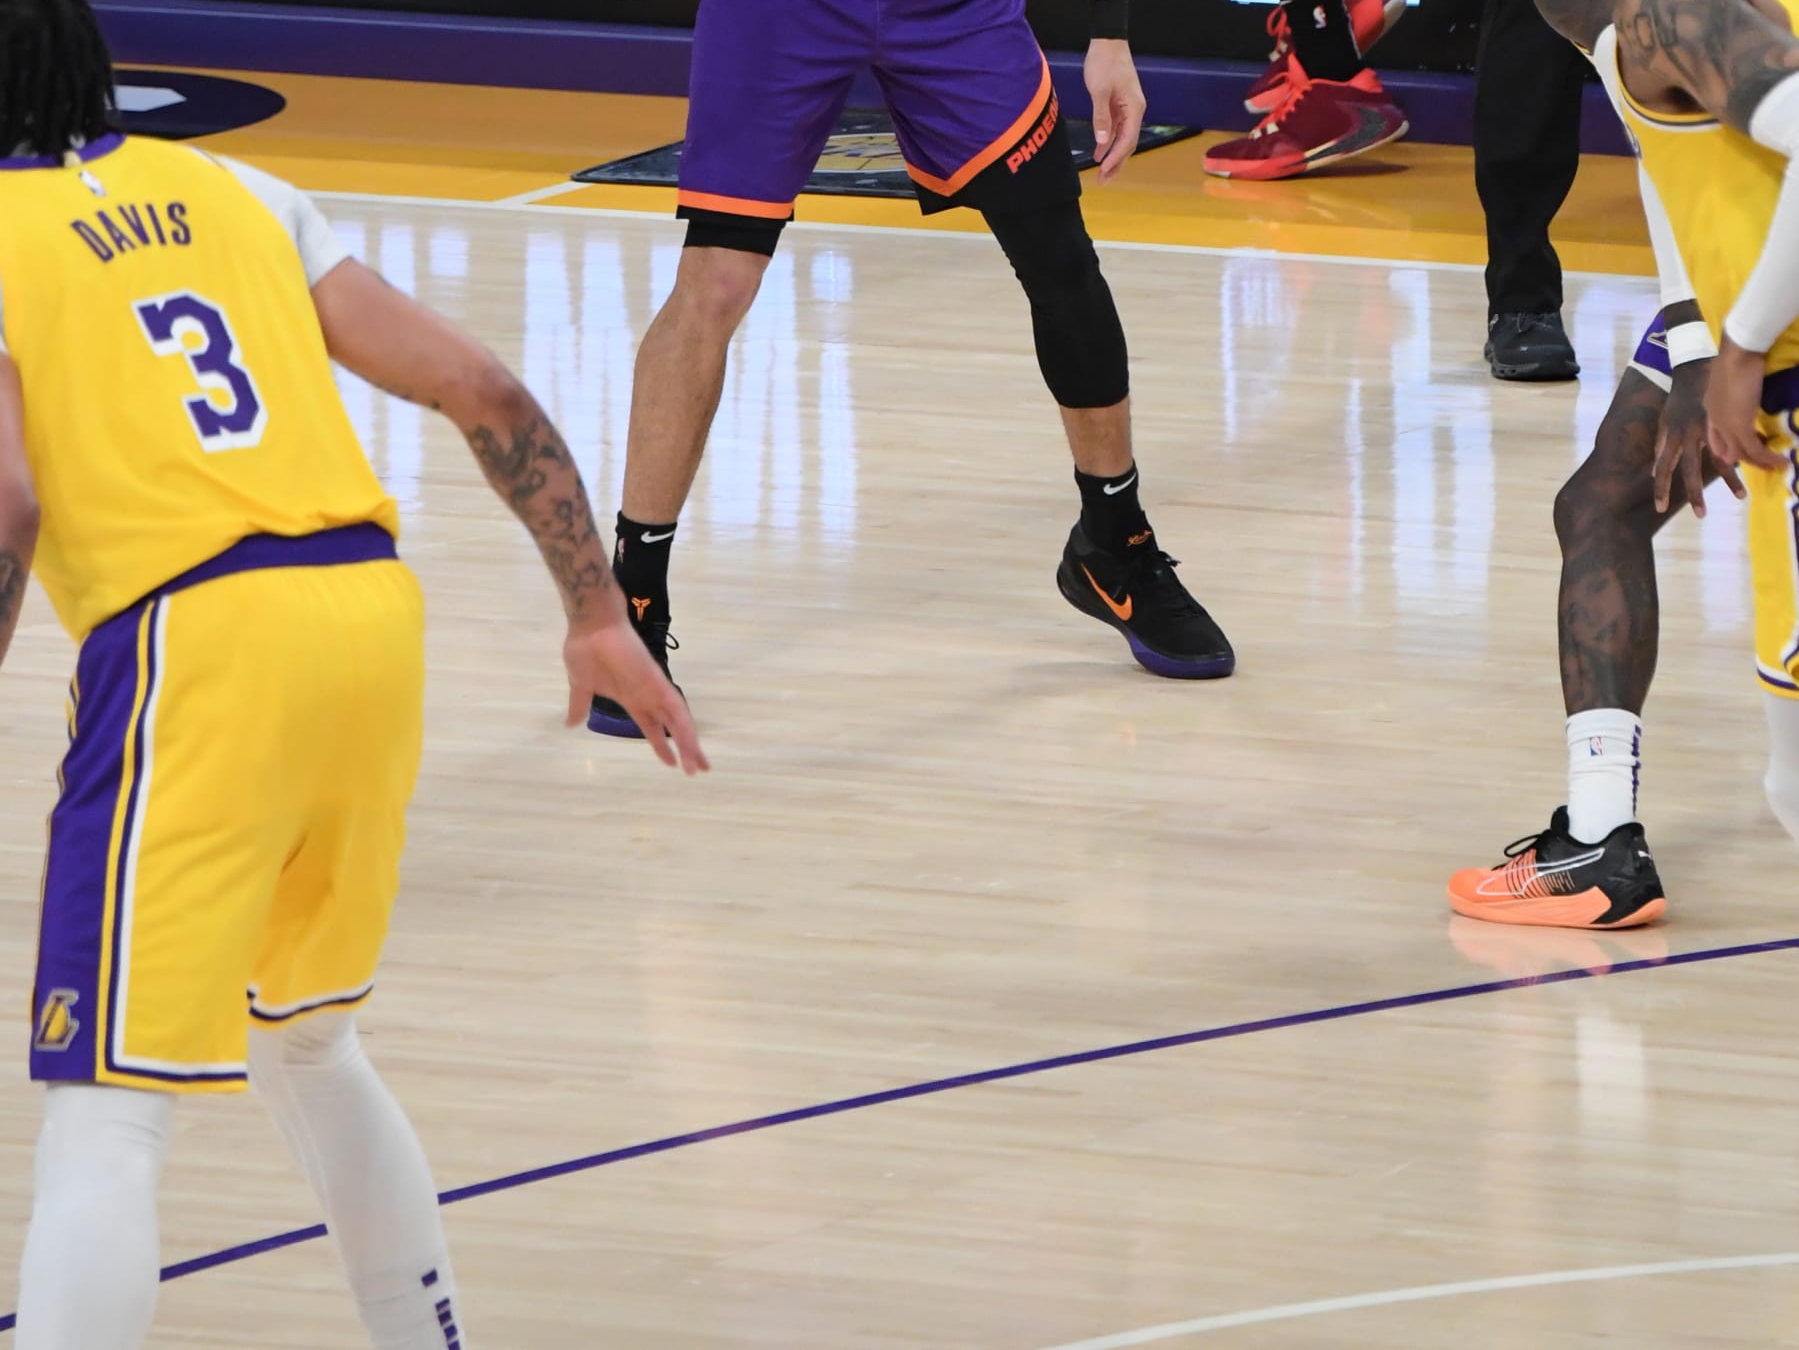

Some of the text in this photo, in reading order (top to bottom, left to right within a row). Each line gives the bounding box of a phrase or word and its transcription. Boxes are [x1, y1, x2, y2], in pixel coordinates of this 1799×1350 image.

[1005, 90, 1059, 175] PHOEN
[70, 201, 192, 264] DAVIS
[131, 288, 268, 453] 3
